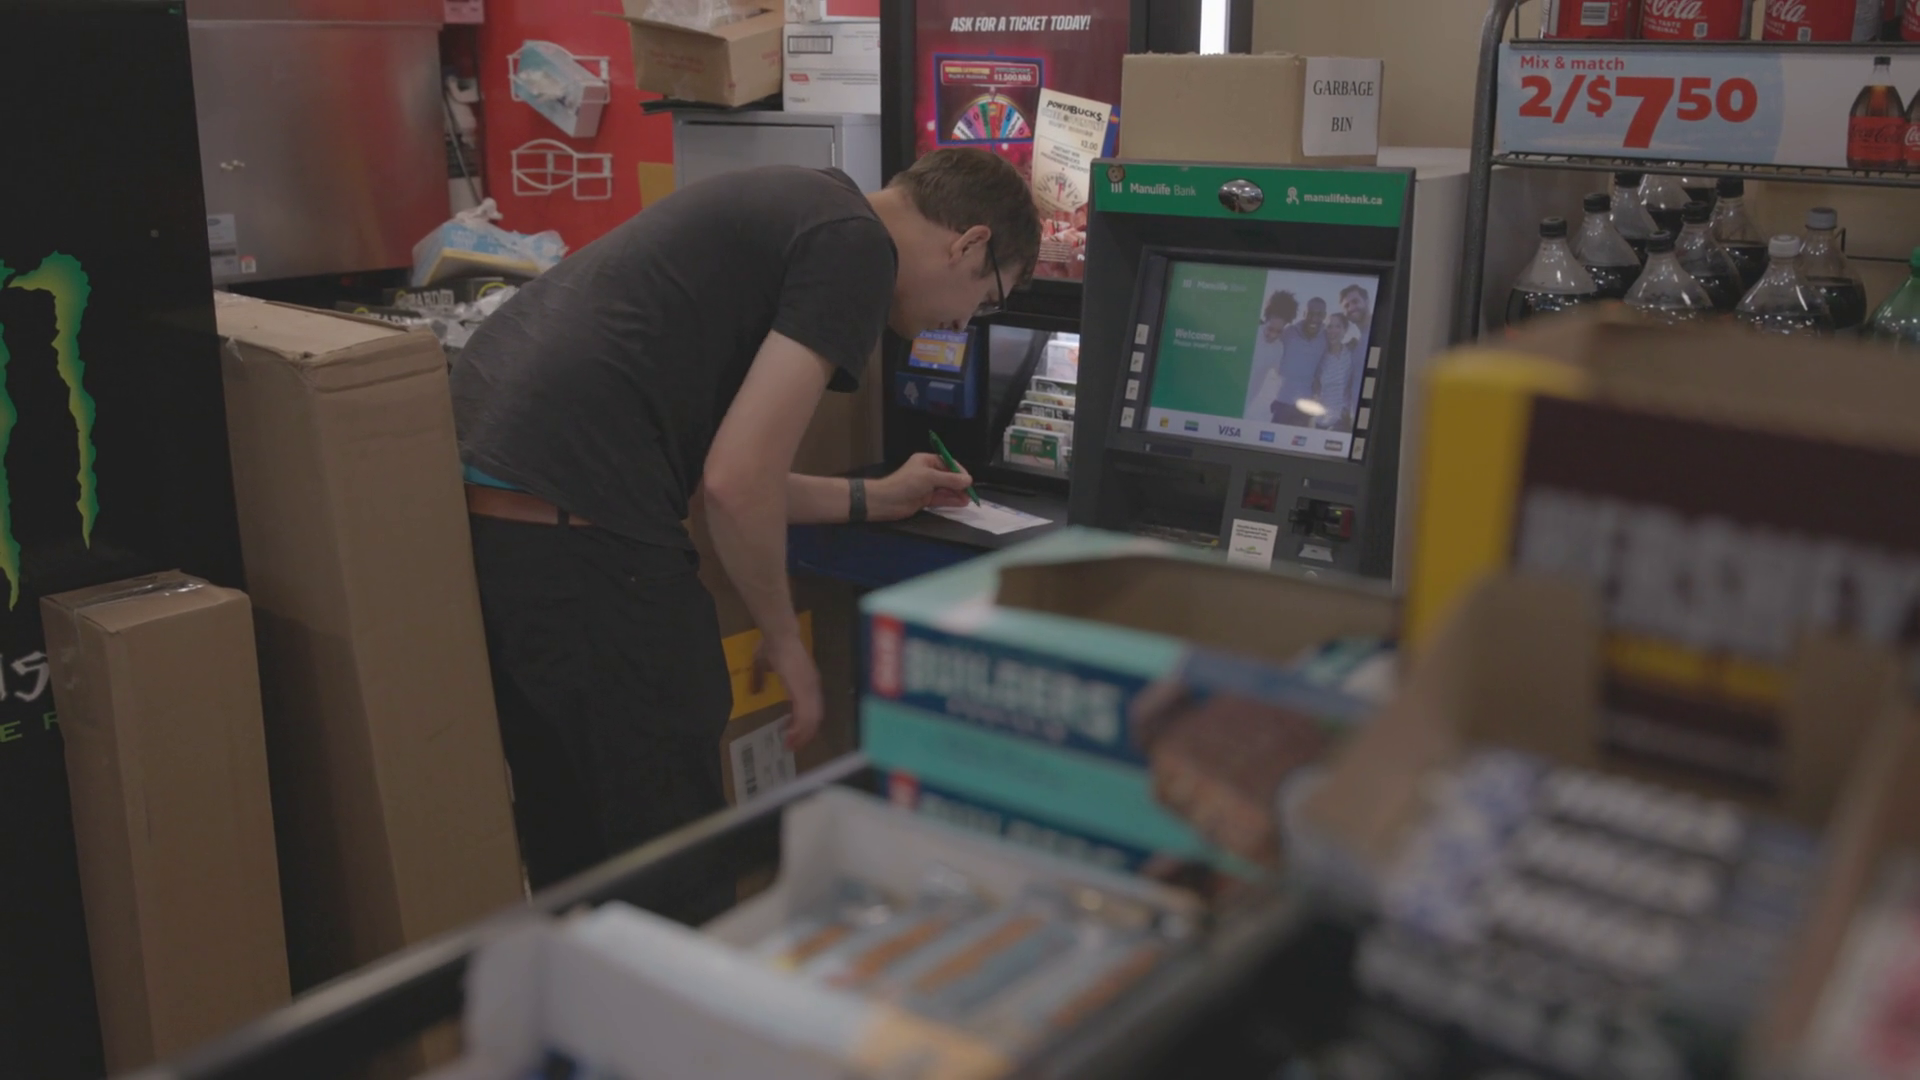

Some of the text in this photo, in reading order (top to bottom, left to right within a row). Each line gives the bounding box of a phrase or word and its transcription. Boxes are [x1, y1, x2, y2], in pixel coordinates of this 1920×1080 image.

[950, 15, 1091, 32] ASK FOR A TICKET TODAY!
[1520, 55, 1625, 72] Mix & match
[1313, 80, 1374, 97] GARBAGE
[1331, 117, 1353, 133] BIN
[1130, 182, 1197, 197] Manulife Bank
[1303, 191, 1383, 206] manulifebank.ca
[1175, 328, 1215, 341] Welcome
[1218, 425, 1241, 438] VISA
